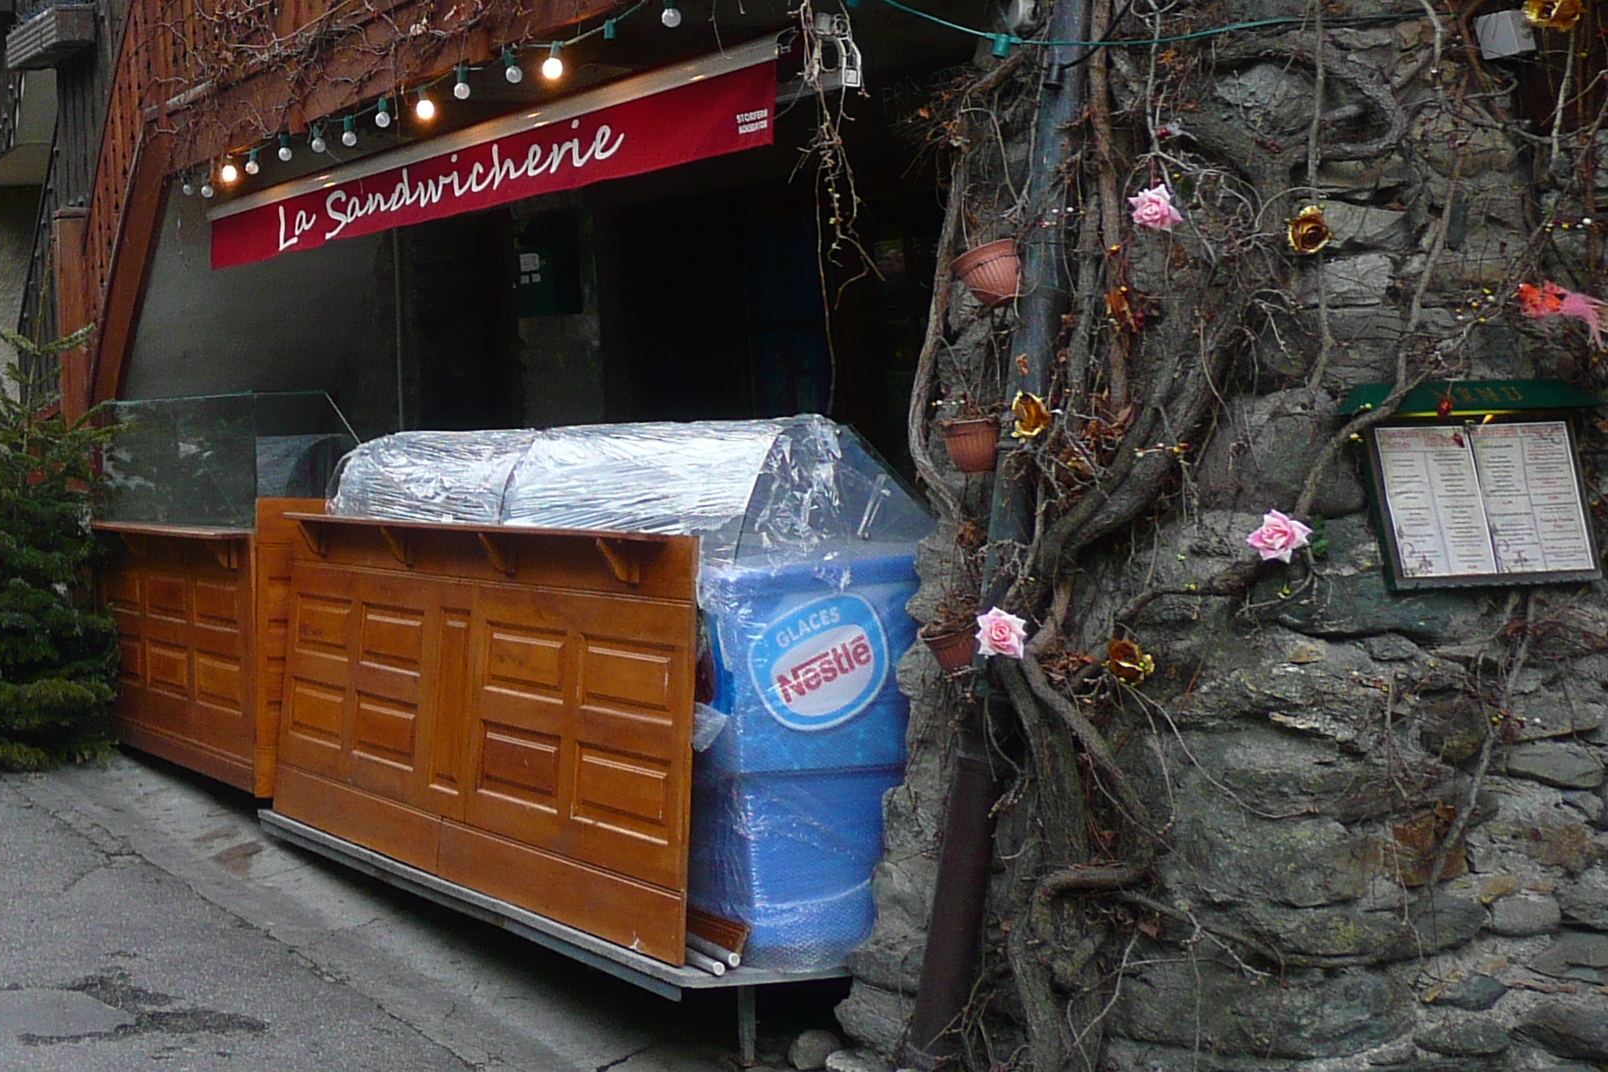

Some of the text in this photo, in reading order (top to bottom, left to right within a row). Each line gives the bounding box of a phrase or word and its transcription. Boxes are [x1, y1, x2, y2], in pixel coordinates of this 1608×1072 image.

[278, 118, 625, 251] La Sandwicherie
[775, 606, 841, 648] GLACES
[776, 634, 871, 704] Nestlé
